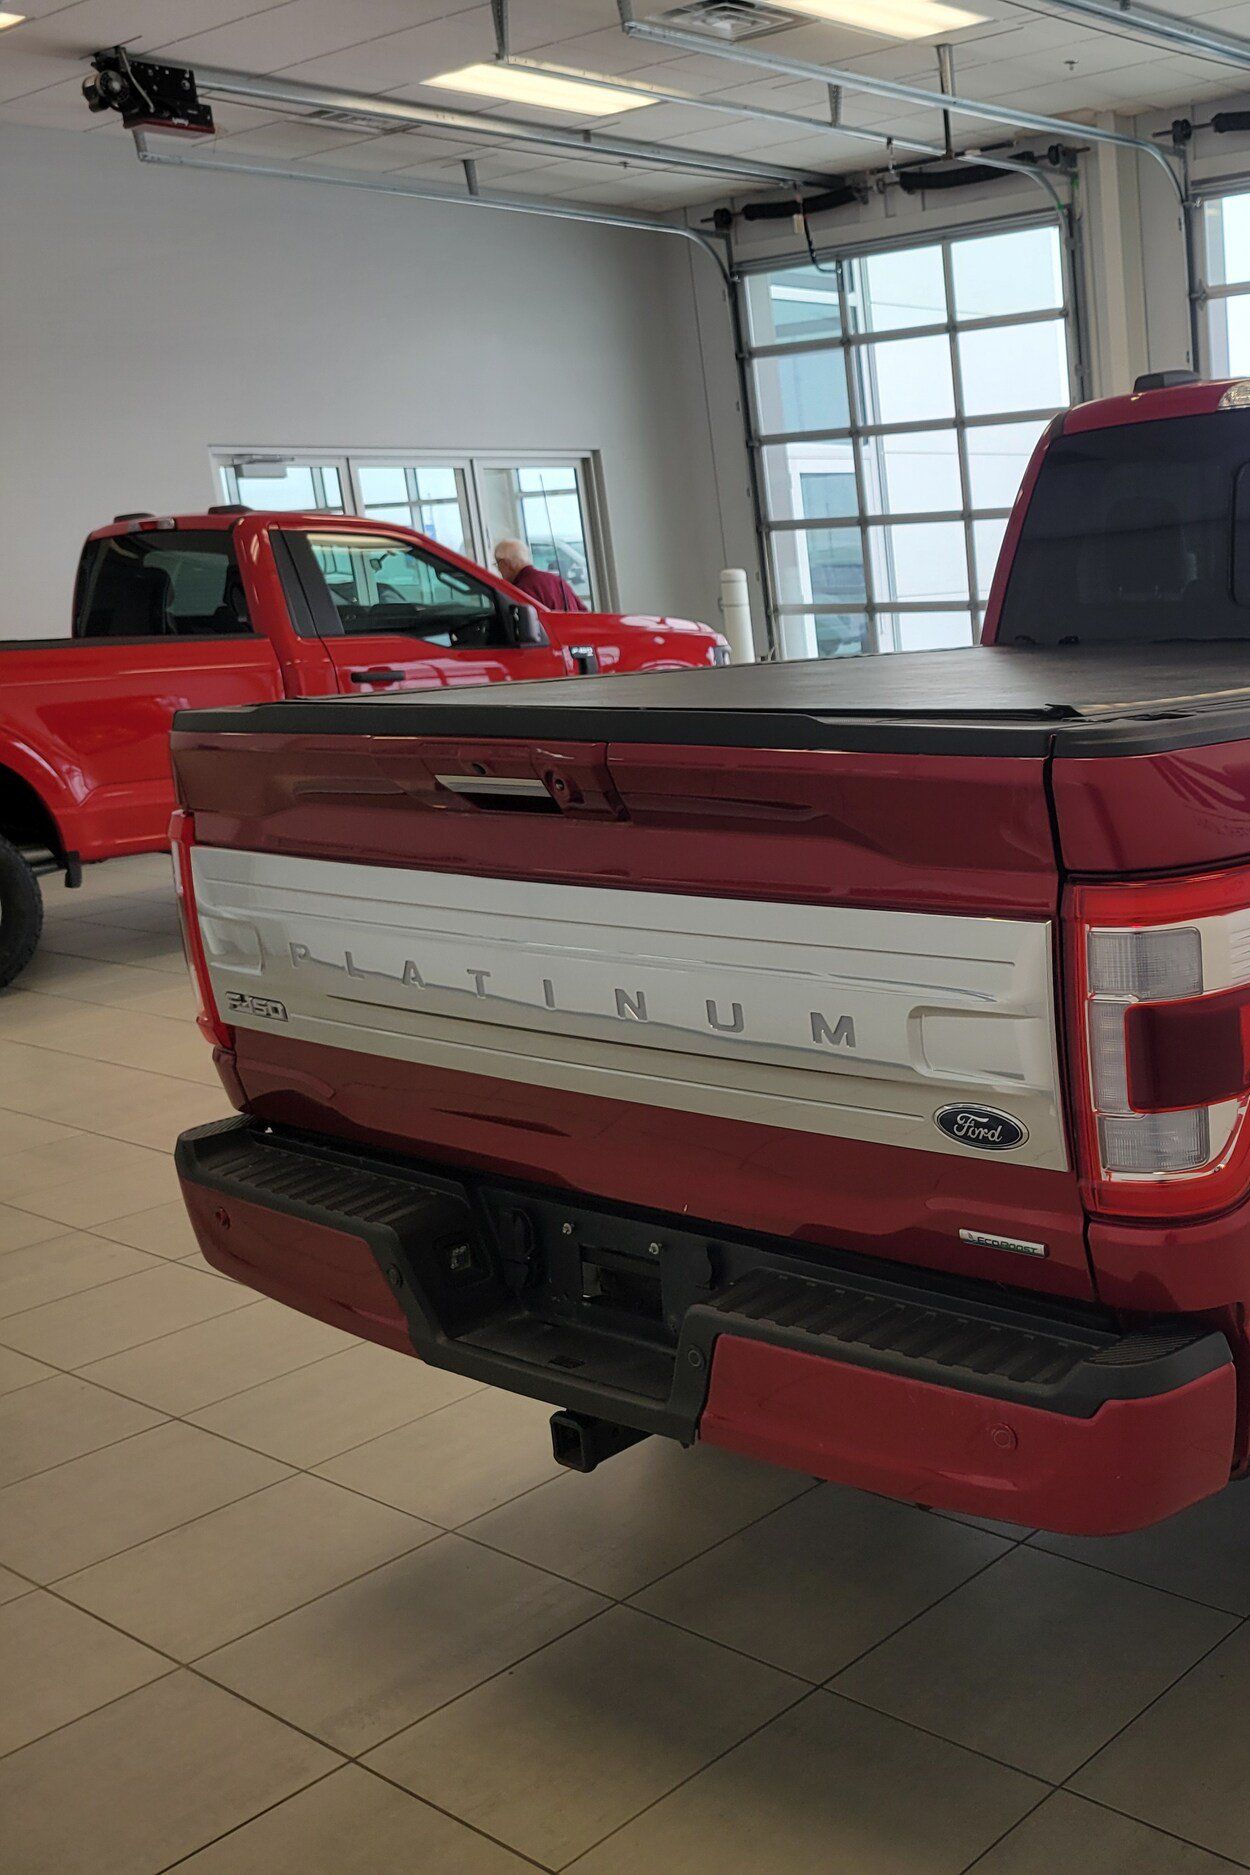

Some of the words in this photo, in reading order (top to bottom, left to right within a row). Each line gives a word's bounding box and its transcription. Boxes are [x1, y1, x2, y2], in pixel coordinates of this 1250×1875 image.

[225, 991, 288, 1022] F-150
[288, 941, 858, 1049] PLATINUM
[953, 1113, 1003, 1143] Ford
